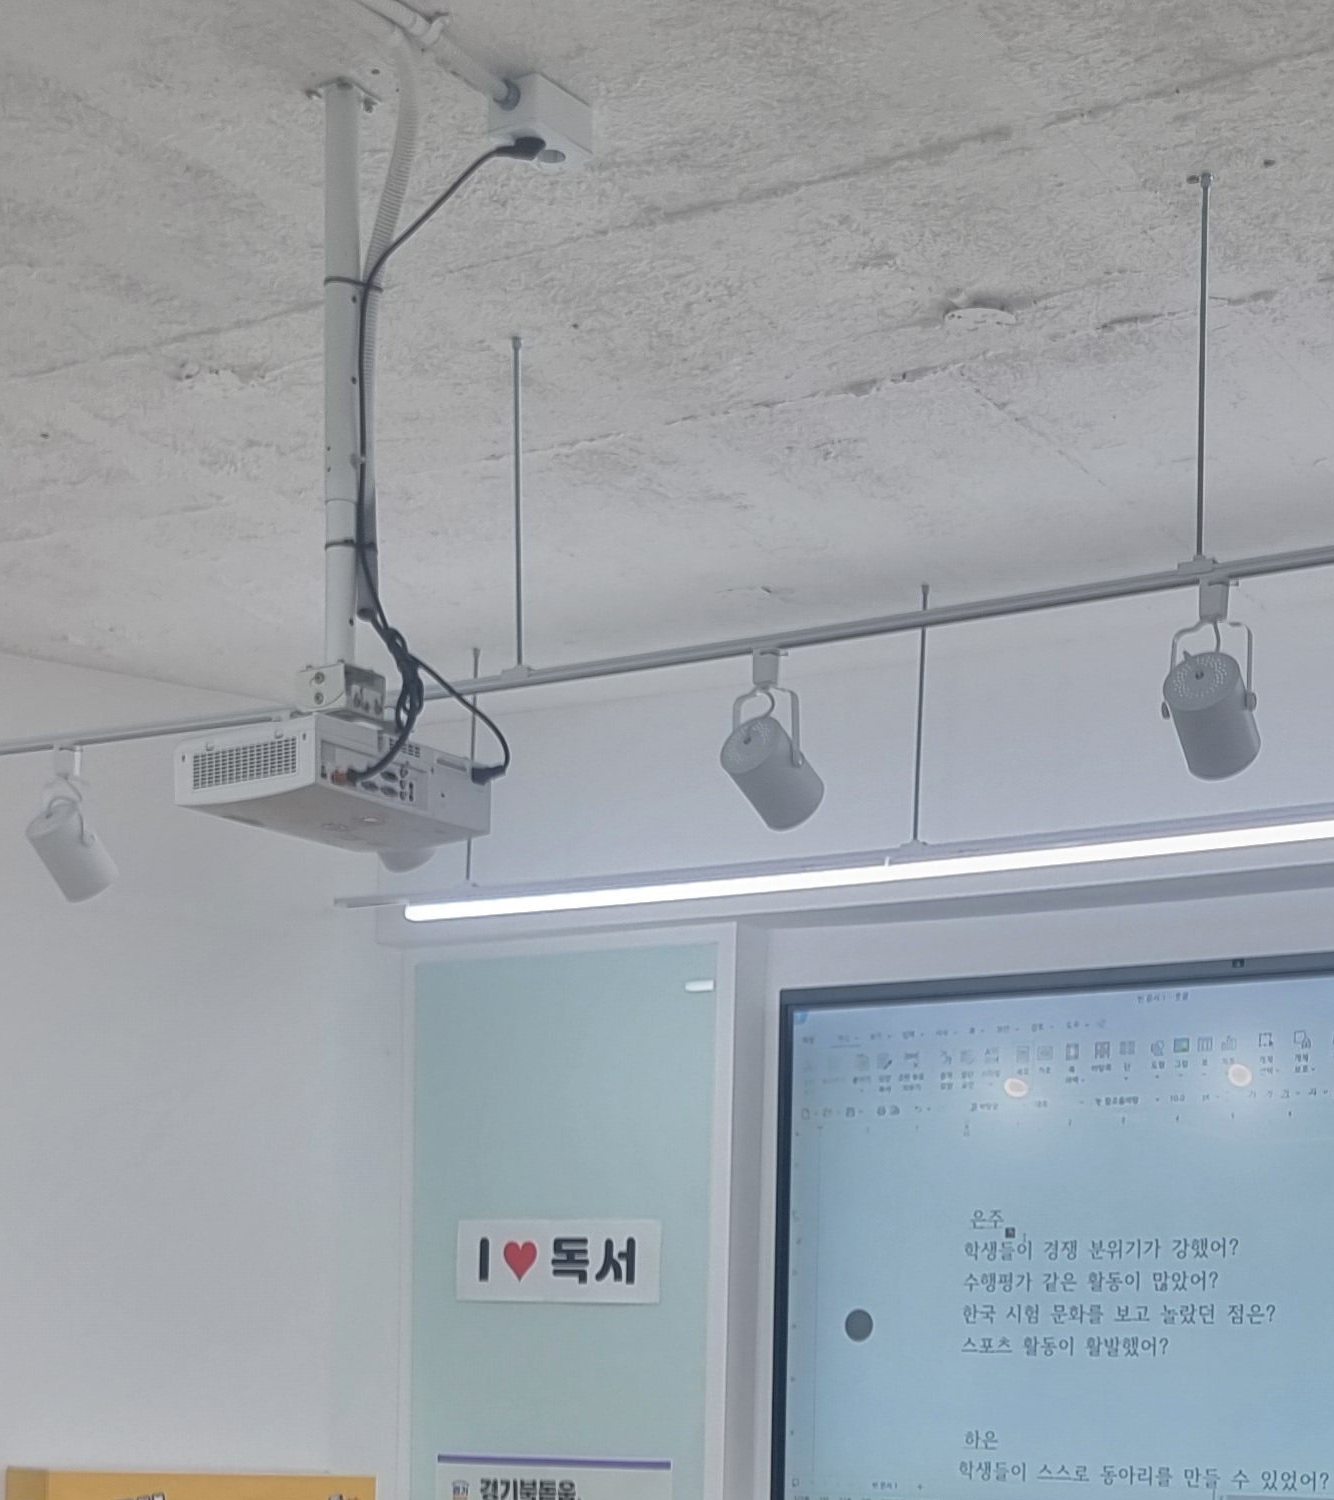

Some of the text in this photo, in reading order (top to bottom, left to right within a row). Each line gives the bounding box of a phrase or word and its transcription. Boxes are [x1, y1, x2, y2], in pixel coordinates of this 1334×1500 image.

[970, 1209, 1004, 1230] 은주
[478, 1236, 637, 1285] I 독서
[964, 1237, 1240, 1262] 학생들이 경쟁 분위기가 강했어?
[963, 1270, 1219, 1293] 수행평가 같은 활동이 많았어?
[962, 1303, 1276, 1325] 한국 시험 문화를 보고 놀랐던 점은?
[961, 1336, 1169, 1358] 스포츠 활동이 활발했어?
[964, 1429, 999, 1450] 하은
[959, 1460, 1330, 1492] 학생들이 스스로 동아리를 만들 수 있었어?
